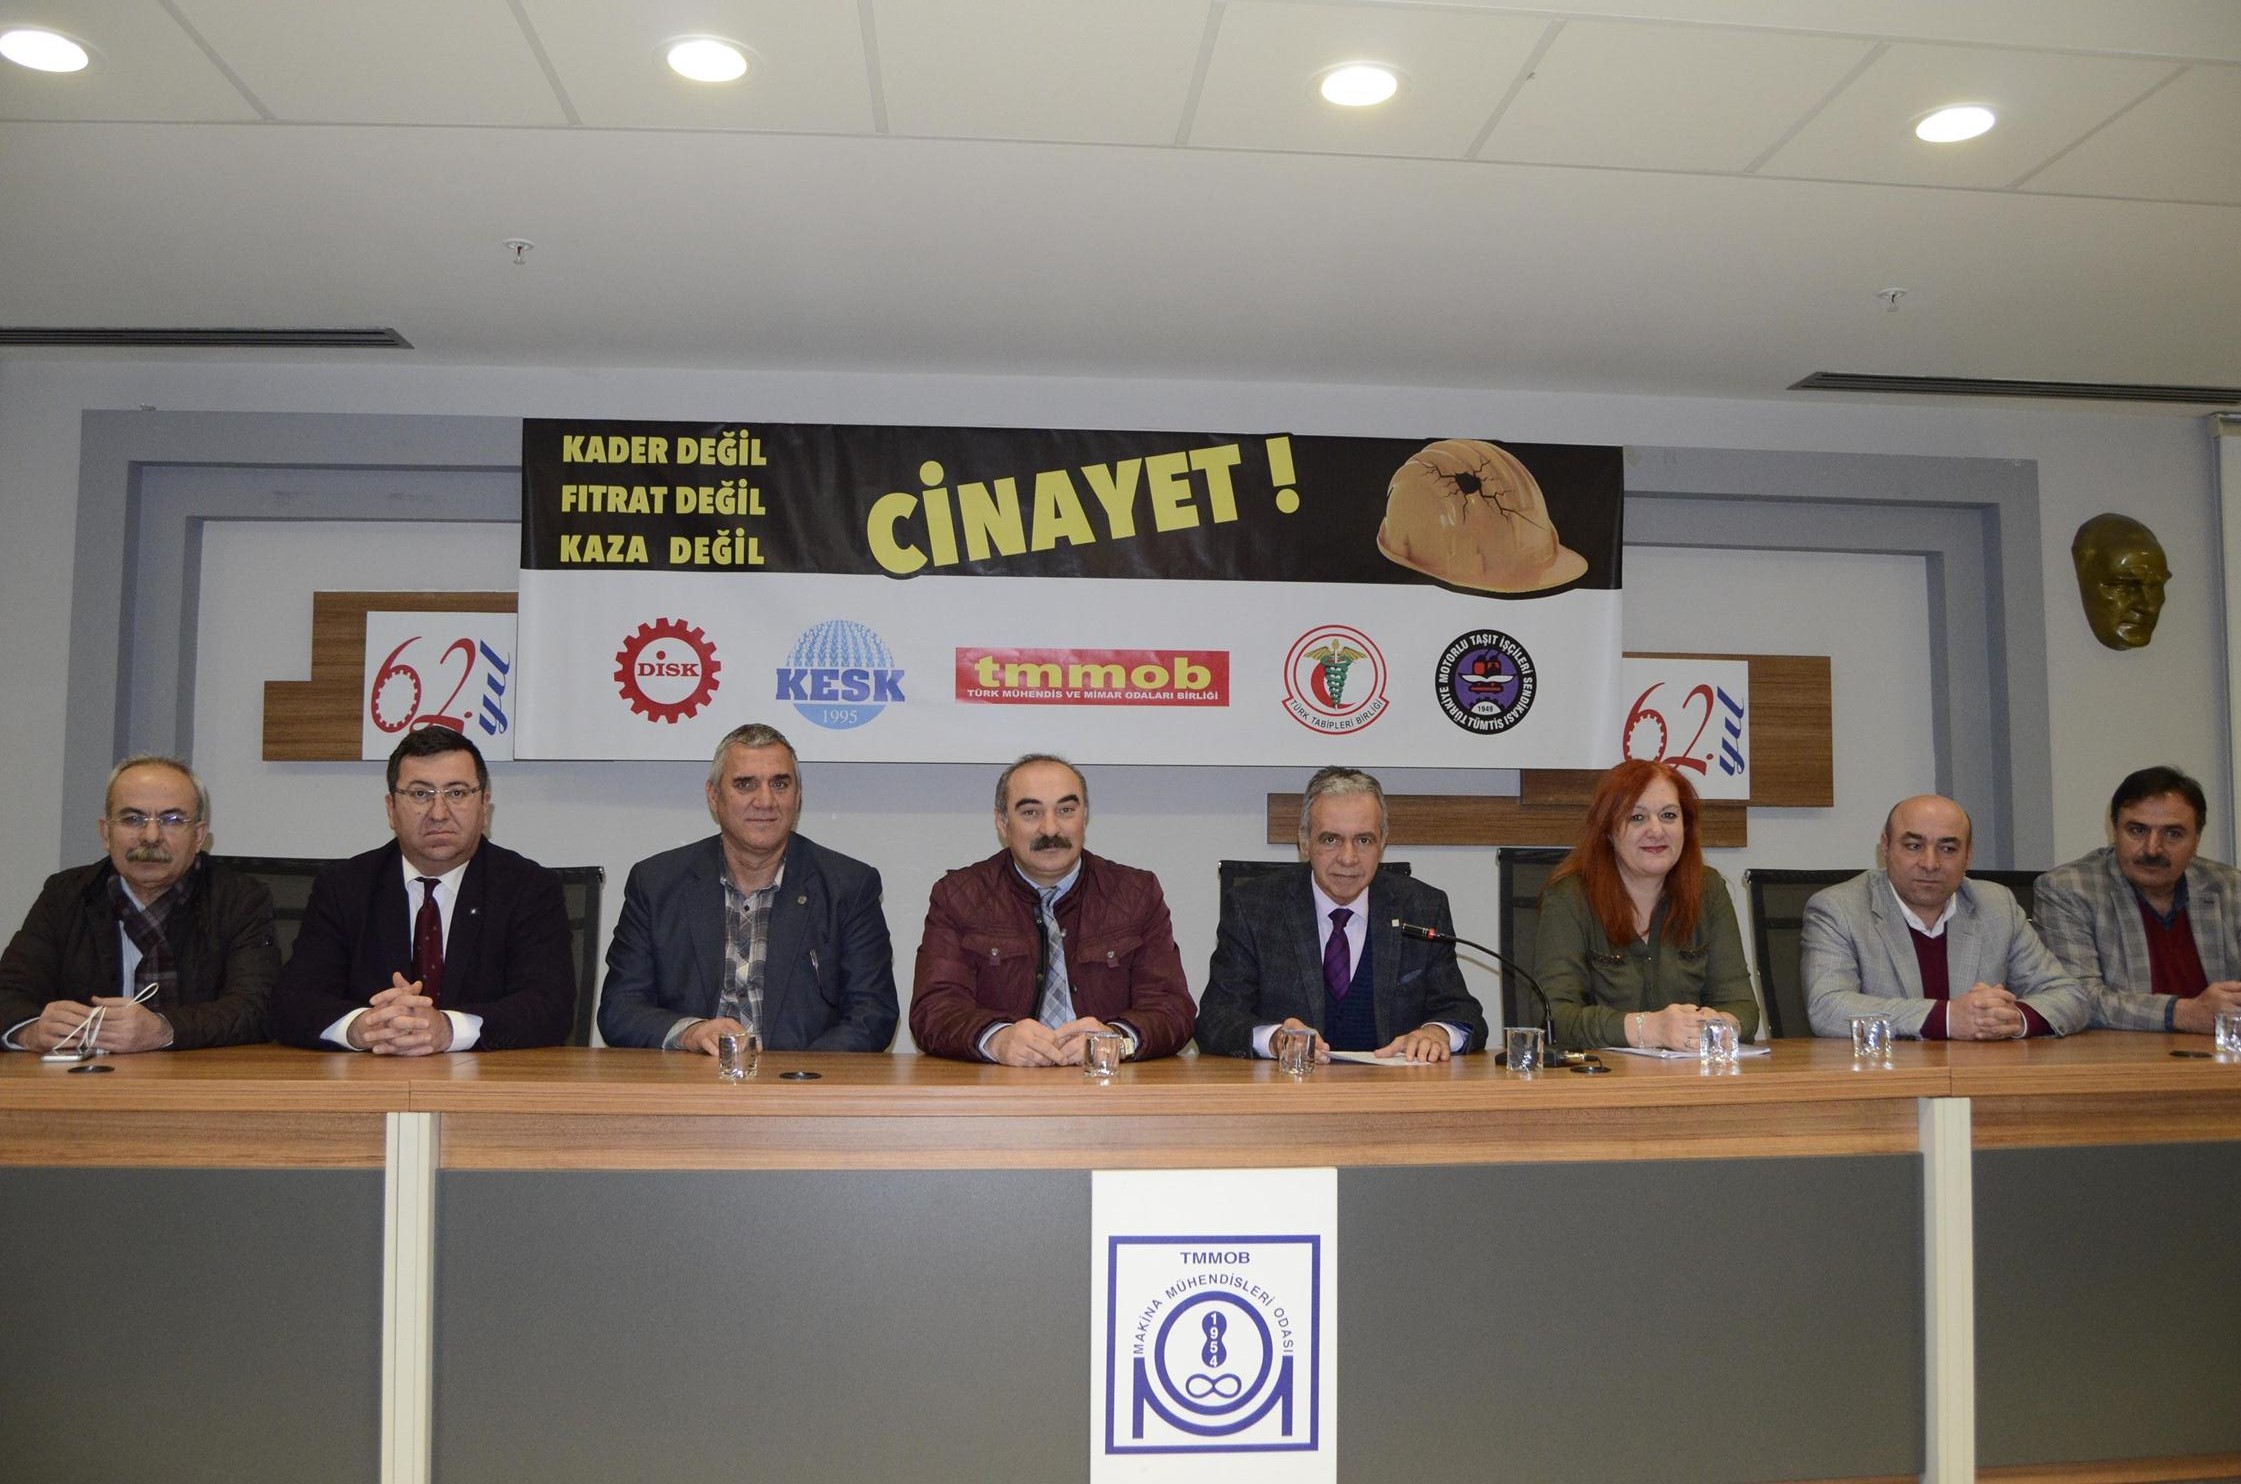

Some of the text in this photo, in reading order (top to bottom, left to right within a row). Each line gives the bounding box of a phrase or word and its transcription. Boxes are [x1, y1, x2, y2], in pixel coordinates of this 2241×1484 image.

[562, 429, 767, 467] KADER DEĞİL
[561, 478, 766, 516] FITRAT DEĞİL
[867, 443, 1241, 575] CİNAYET
[560, 528, 765, 565] KAZA DEĞİL
[637, 650, 700, 678] DİSK
[974, 655, 1212, 690] tmmob
[1438, 634, 1533, 725] TÜRKİYE MOTORLU TAŞIT İŞÇİLERİ SENDİKASI
[775, 667, 906, 703] KESK
[967, 689, 1219, 701] TÜRK MÜHENDİS VE MİMAR ODALARI BİRLİĞİ
[821, 708, 858, 725] 1995
[1290, 699, 1383, 730] TÜRK TABİPLERİ BİRLİĞİ
[1467, 717, 1504, 730] TÜMTİS
[1478, 705, 1494, 713] 1949
[1180, 1251, 1250, 1264] TMMOB
[1133, 1272, 1294, 1355] MAKİNA MÜHENDİSLERİ ODASI
[1208, 1312, 1219, 1368] 1954
